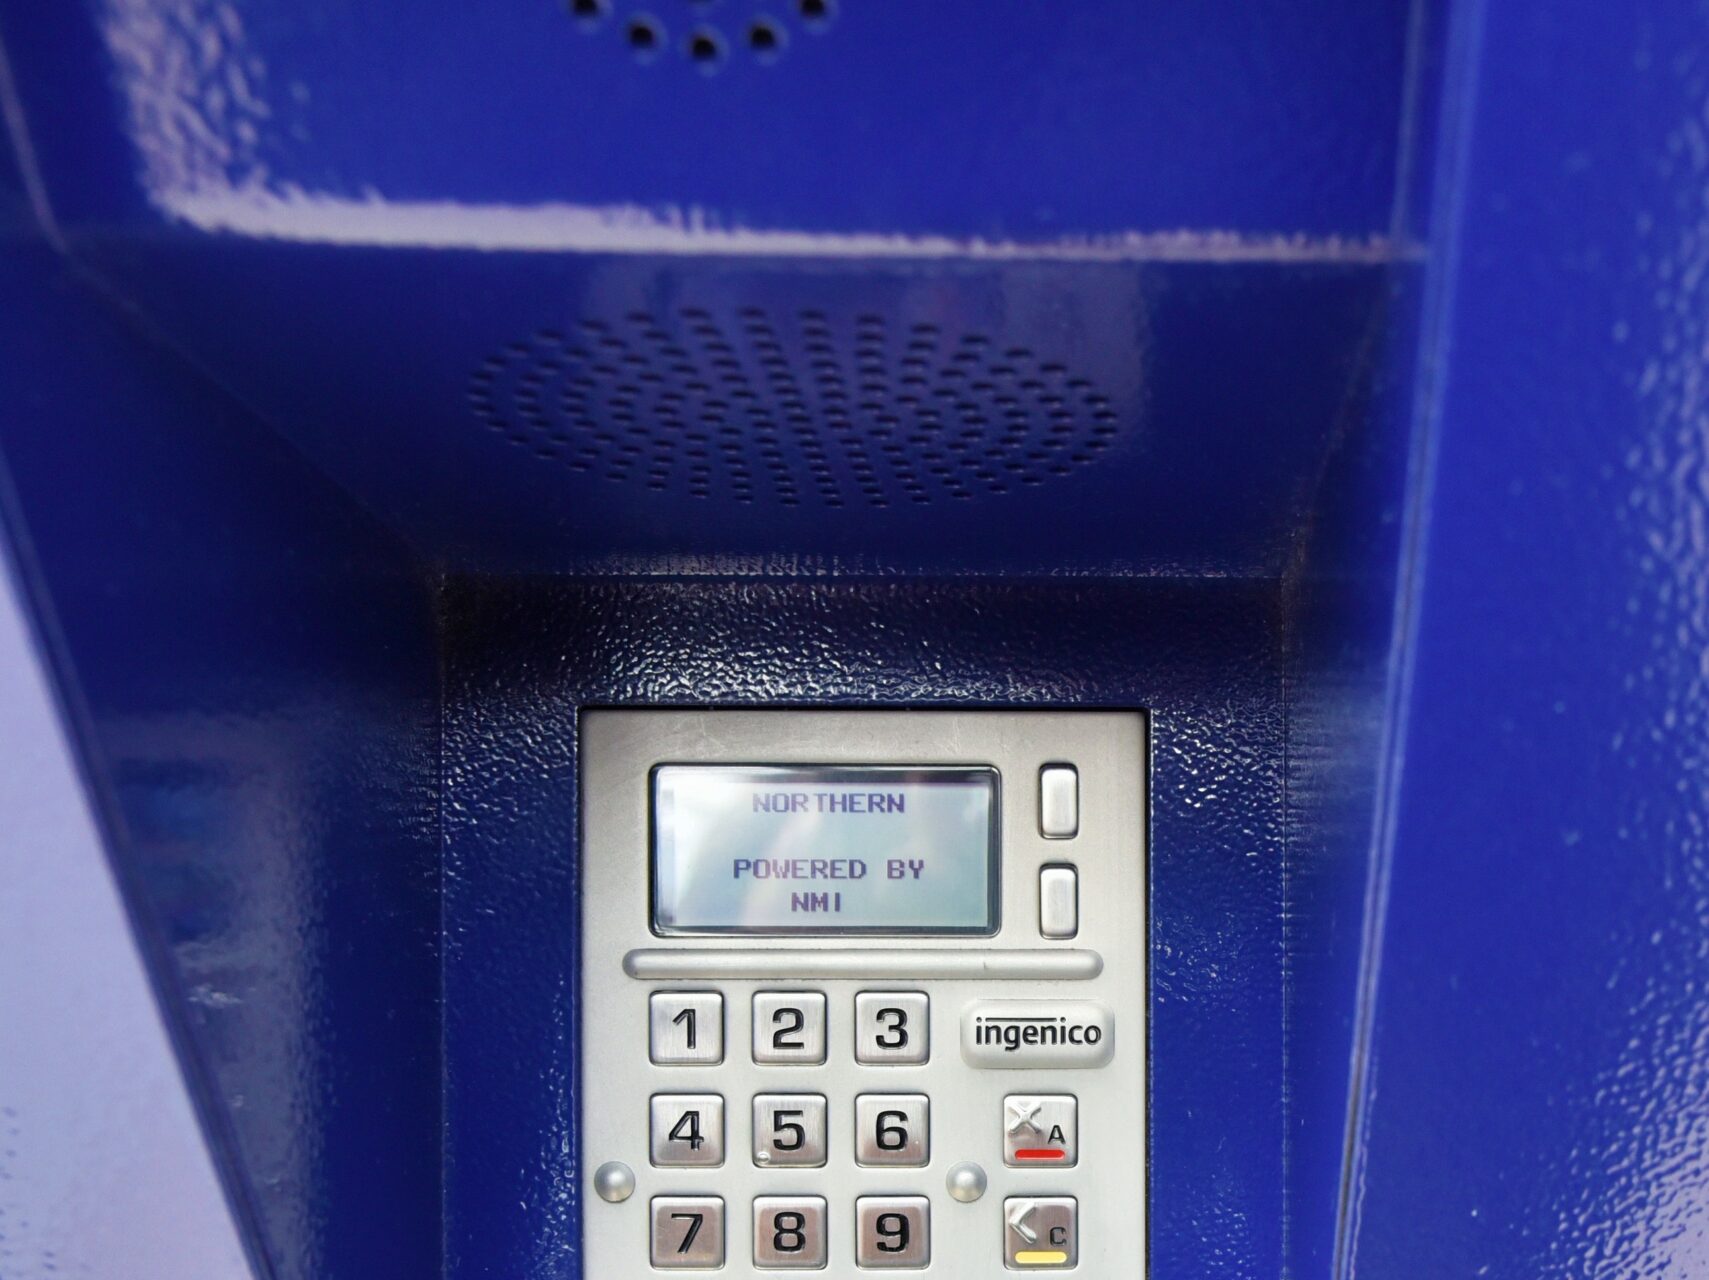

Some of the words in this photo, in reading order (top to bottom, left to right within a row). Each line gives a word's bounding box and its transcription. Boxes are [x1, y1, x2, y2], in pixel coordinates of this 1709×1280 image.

[753, 793, 905, 813] NORTHERN
[734, 859, 866, 880] POWERED
[887, 859, 925, 880] BY
[791, 893, 842, 913] NMI
[672, 1008, 697, 1050] 1
[772, 1007, 805, 1050] 2
[875, 1007, 908, 1050] 3
[975, 1016, 1102, 1051] ingenico
[668, 1110, 705, 1151] 4
[772, 1110, 806, 1151] 5
[875, 1110, 908, 1151] 6
[1047, 1125, 1067, 1145] A
[670, 1213, 703, 1254] 7
[772, 1212, 807, 1253] 8
[875, 1212, 910, 1253] 9
[1049, 1226, 1067, 1247] C
